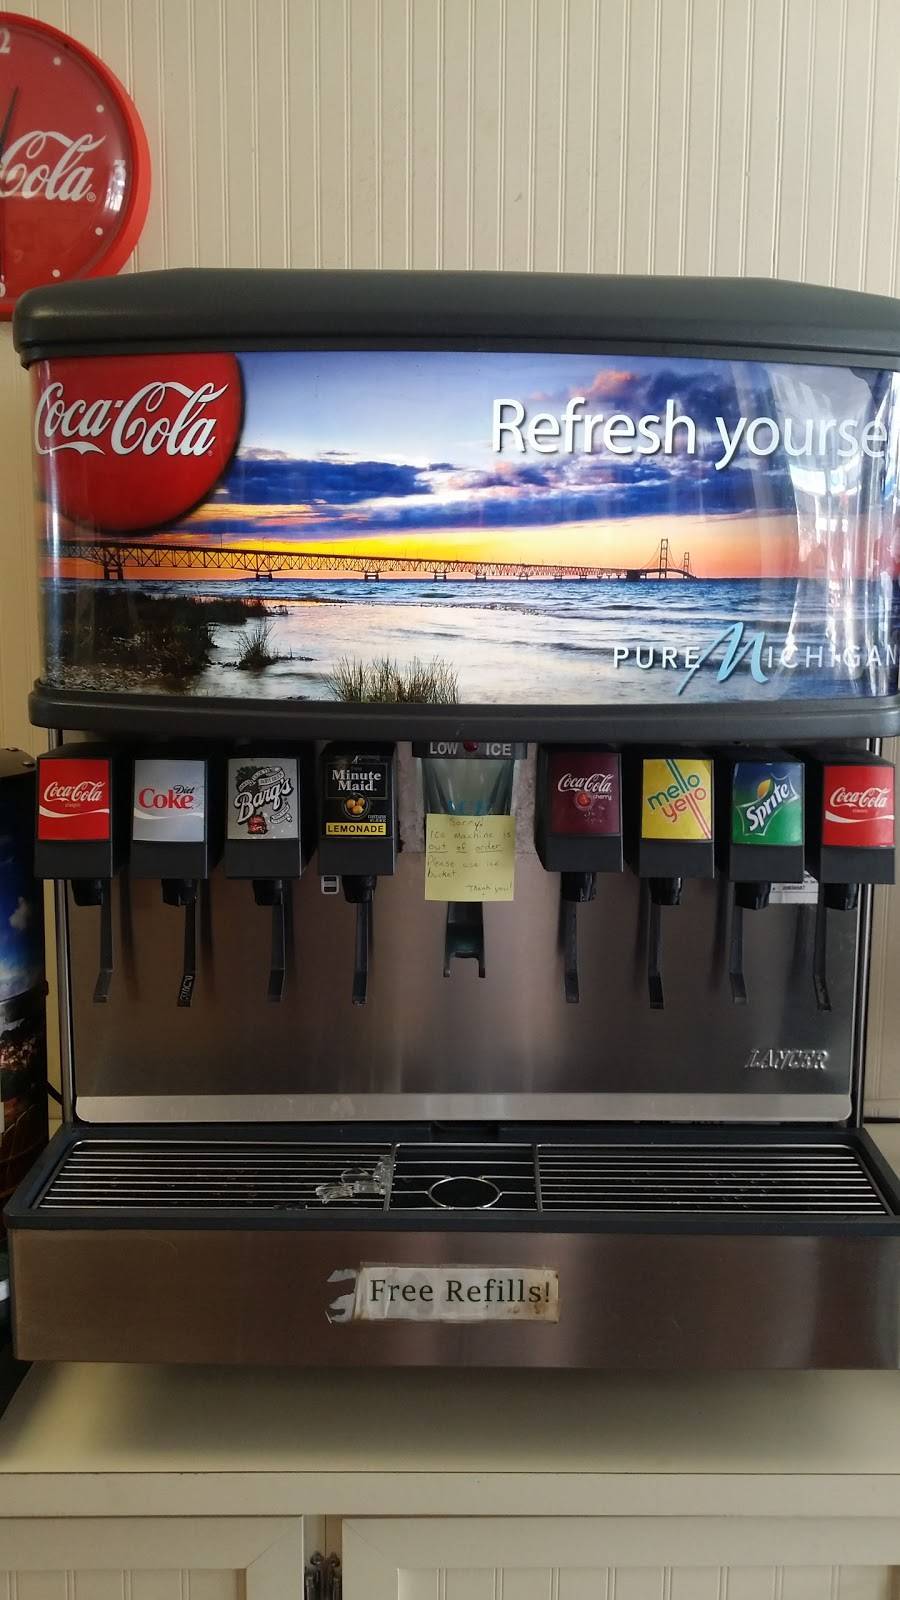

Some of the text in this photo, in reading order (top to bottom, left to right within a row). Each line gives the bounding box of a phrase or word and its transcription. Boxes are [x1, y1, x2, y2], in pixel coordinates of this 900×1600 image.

[34, 381, 229, 456] Coca-Cola
[491, 396, 697, 455] Refresh
[613, 645, 702, 670] PURE
[429, 741, 512, 757] LOW ICE
[332, 768, 382, 781] Minute
[337, 780, 375, 792] Maid
[557, 772, 615, 793] Coca-Cola
[43, 780, 106, 803] Coca-Cola
[138, 787, 195, 811] Coke
[173, 784, 196, 795] Diet
[647, 765, 701, 811] mello
[829, 786, 890, 809] Coca-Cola
[233, 777, 295, 825] Barq's
[661, 787, 708, 824] yello
[745, 782, 790, 832] Sprite
[327, 824, 385, 834] LEMONADE
[369, 1278, 551, 1304] Free Refills!
